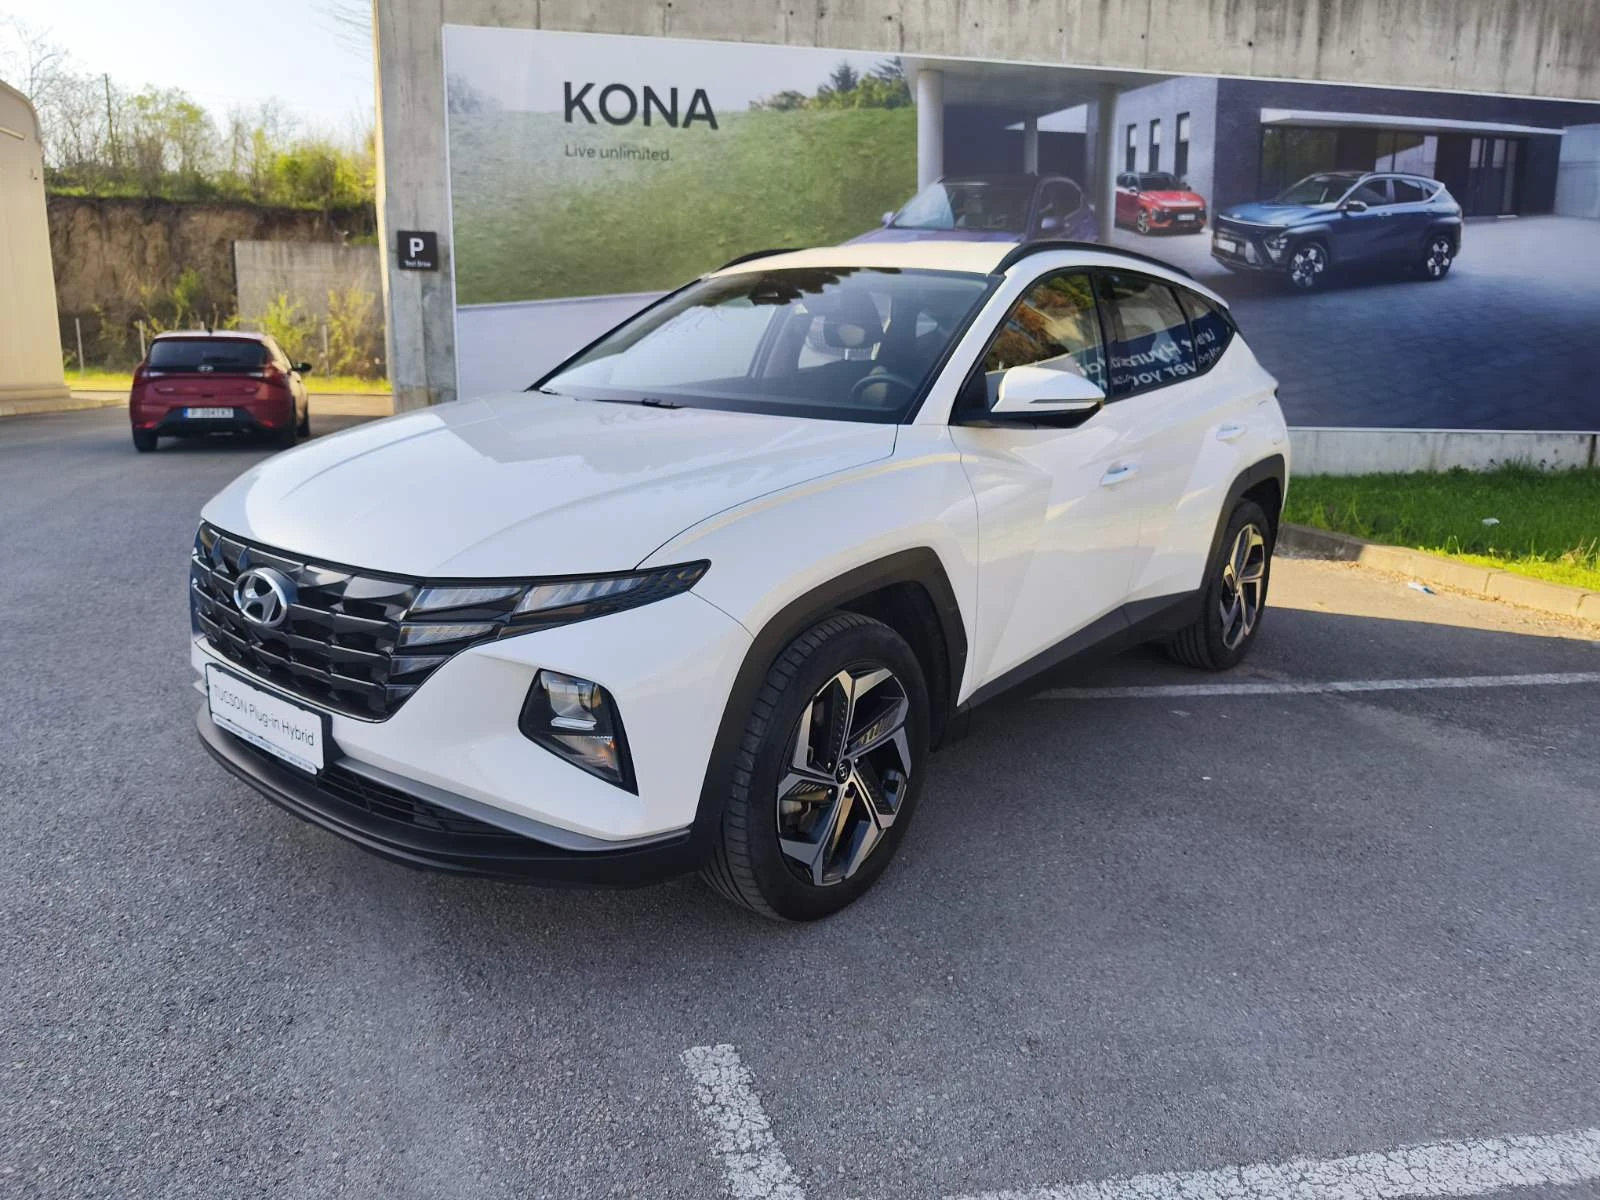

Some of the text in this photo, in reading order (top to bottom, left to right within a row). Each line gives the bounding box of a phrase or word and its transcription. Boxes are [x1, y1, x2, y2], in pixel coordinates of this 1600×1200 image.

[564, 81, 719, 130] KONA
[564, 144, 674, 161] Live unlimited.
[409, 238, 424, 258] P
[282, 719, 315, 747] Hybrid
